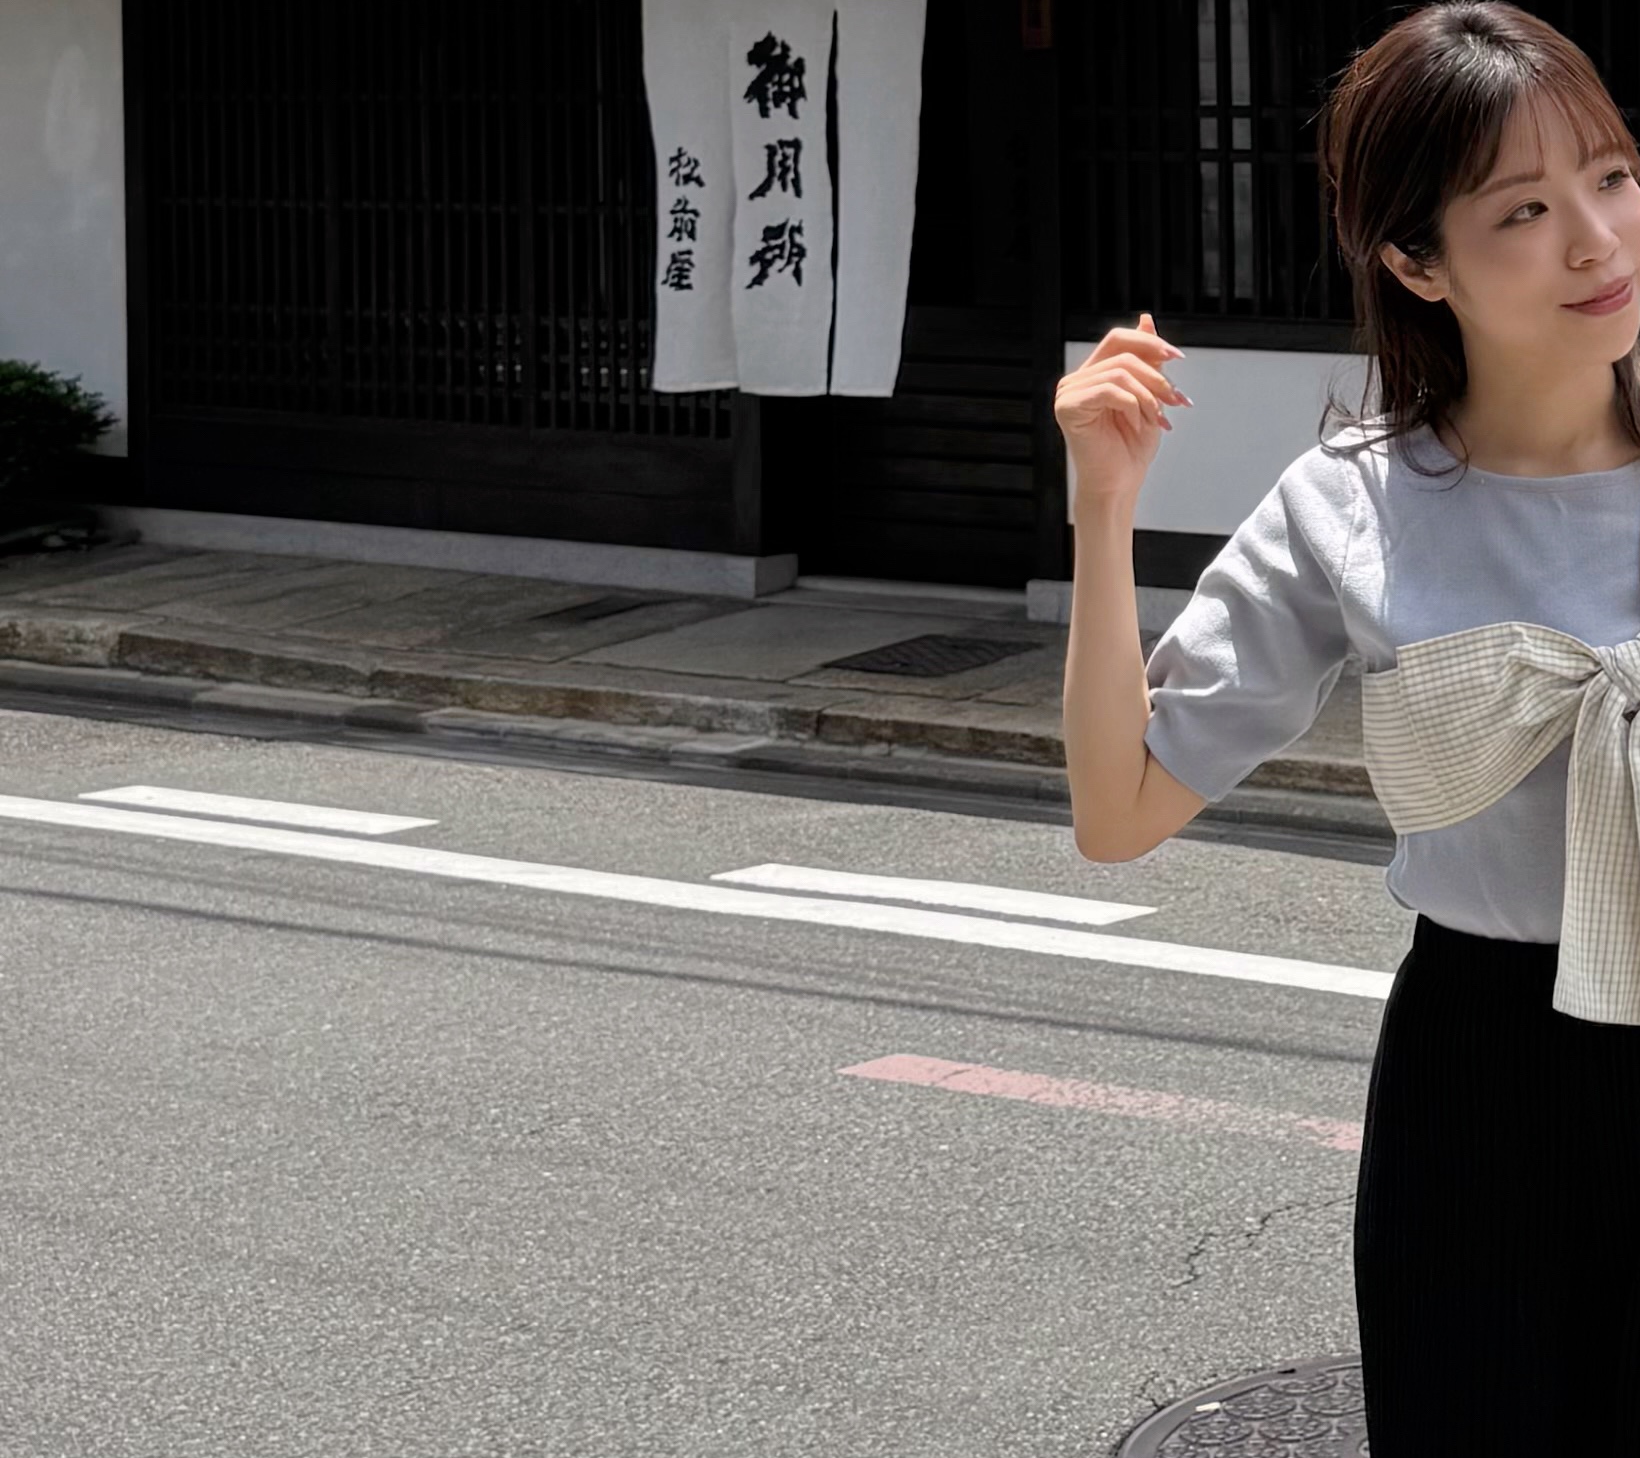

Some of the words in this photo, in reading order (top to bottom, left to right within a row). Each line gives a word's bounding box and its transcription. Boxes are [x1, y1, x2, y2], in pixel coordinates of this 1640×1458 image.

[661, 147, 705, 291] 松前屋
[743, 31, 807, 290] 御用所
